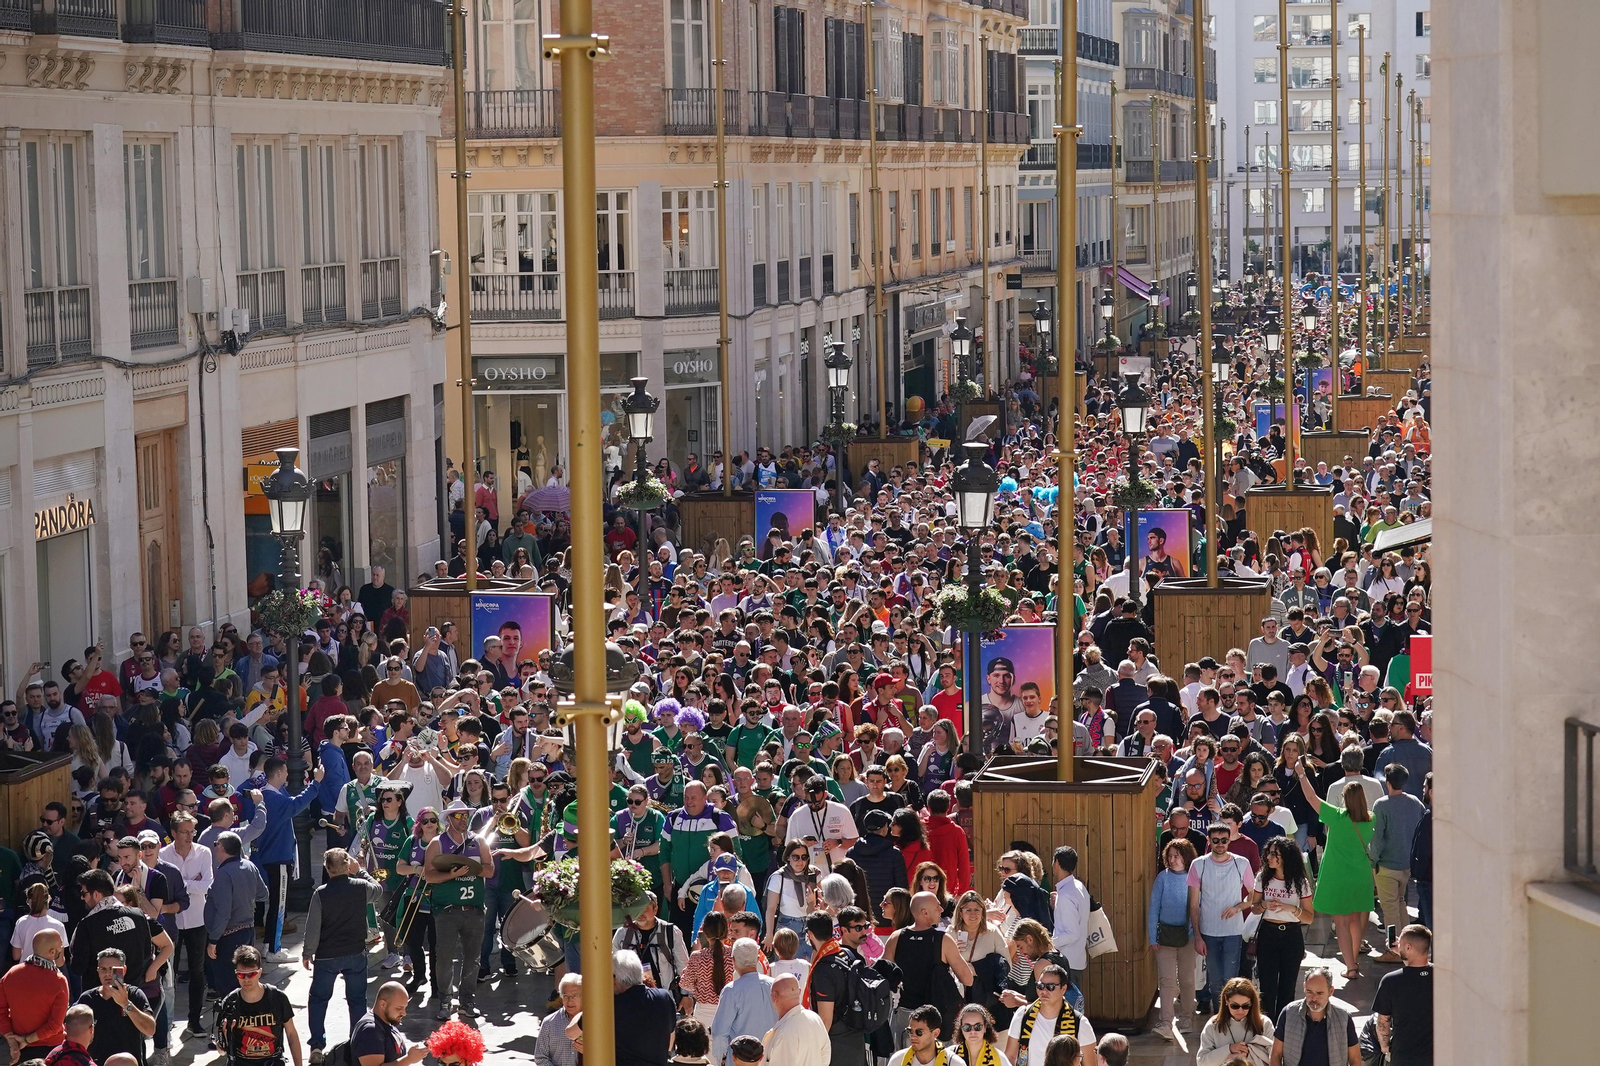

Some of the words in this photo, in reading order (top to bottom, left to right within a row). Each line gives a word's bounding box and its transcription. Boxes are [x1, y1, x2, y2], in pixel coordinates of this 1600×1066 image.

[673, 358, 713, 375] OYSHO
[484, 366, 547, 381] OYSHO
[460, 886, 475, 900] 25
[106, 921, 125, 932] NORTH
[112, 917, 124, 925] THE
[113, 926, 127, 935] FACE
